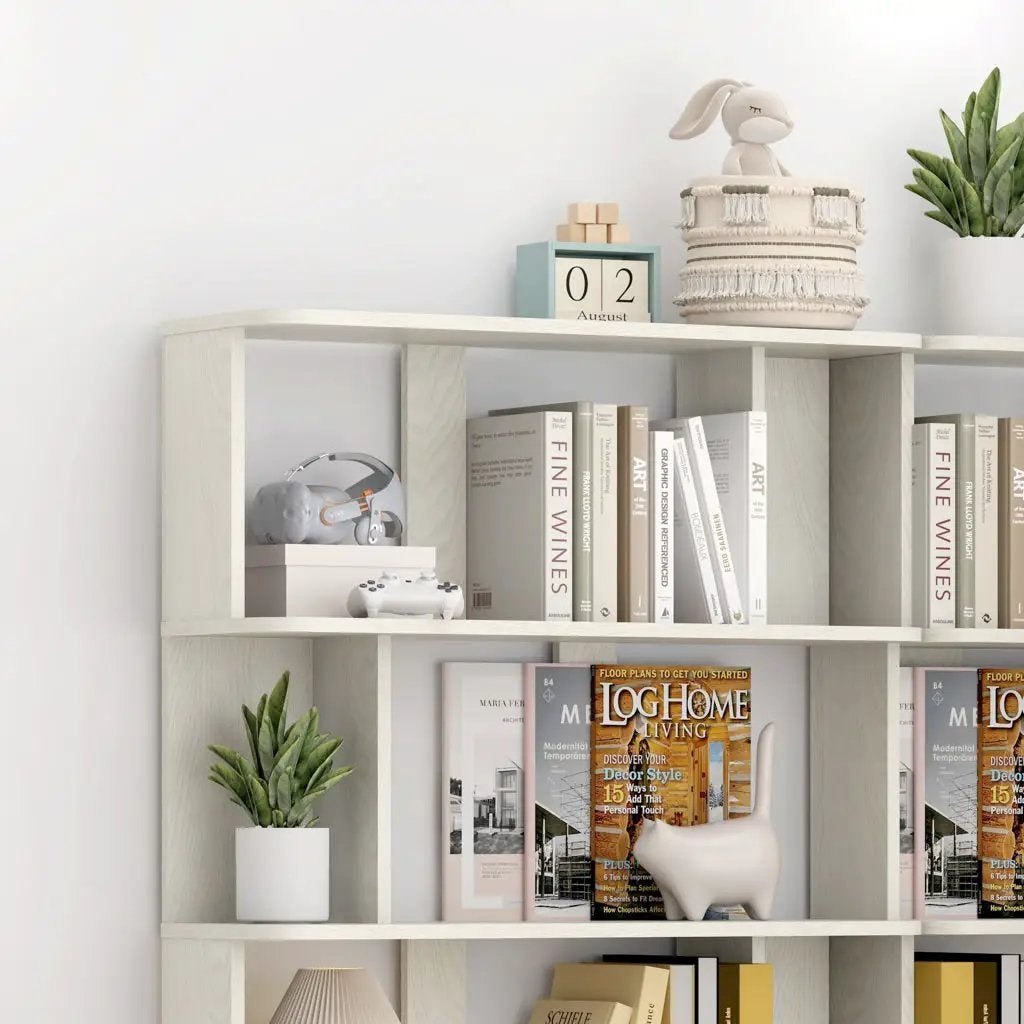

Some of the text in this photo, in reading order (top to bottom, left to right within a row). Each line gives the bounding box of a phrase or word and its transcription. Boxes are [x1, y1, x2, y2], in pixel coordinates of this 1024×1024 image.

[566, 265, 636, 304] 0 2
[577, 309, 628, 322] August
[551, 440, 567, 497] FINE
[632, 456, 647, 491] ART
[751, 462, 765, 495] ART
[936, 452, 951, 506] FINE
[551, 510, 567, 594] WINES
[936, 519, 951, 601] WINES
[600, 669, 748, 680] FLOOR PLANS TO GET YOU STARTED
[986, 672, 1013, 682] FLOOR
[644, 722, 707, 739] LIVING
[603, 754, 667, 765] DISCOVER YOUR
[603, 768, 682, 784] Decor Style
[603, 784, 624, 803] 15
[626, 783, 658, 795] Ways to
[990, 785, 1010, 804] 15
[626, 794, 663, 804] Add That
[603, 806, 664, 815] Personal Touch
[990, 806, 1024, 815] Personal
